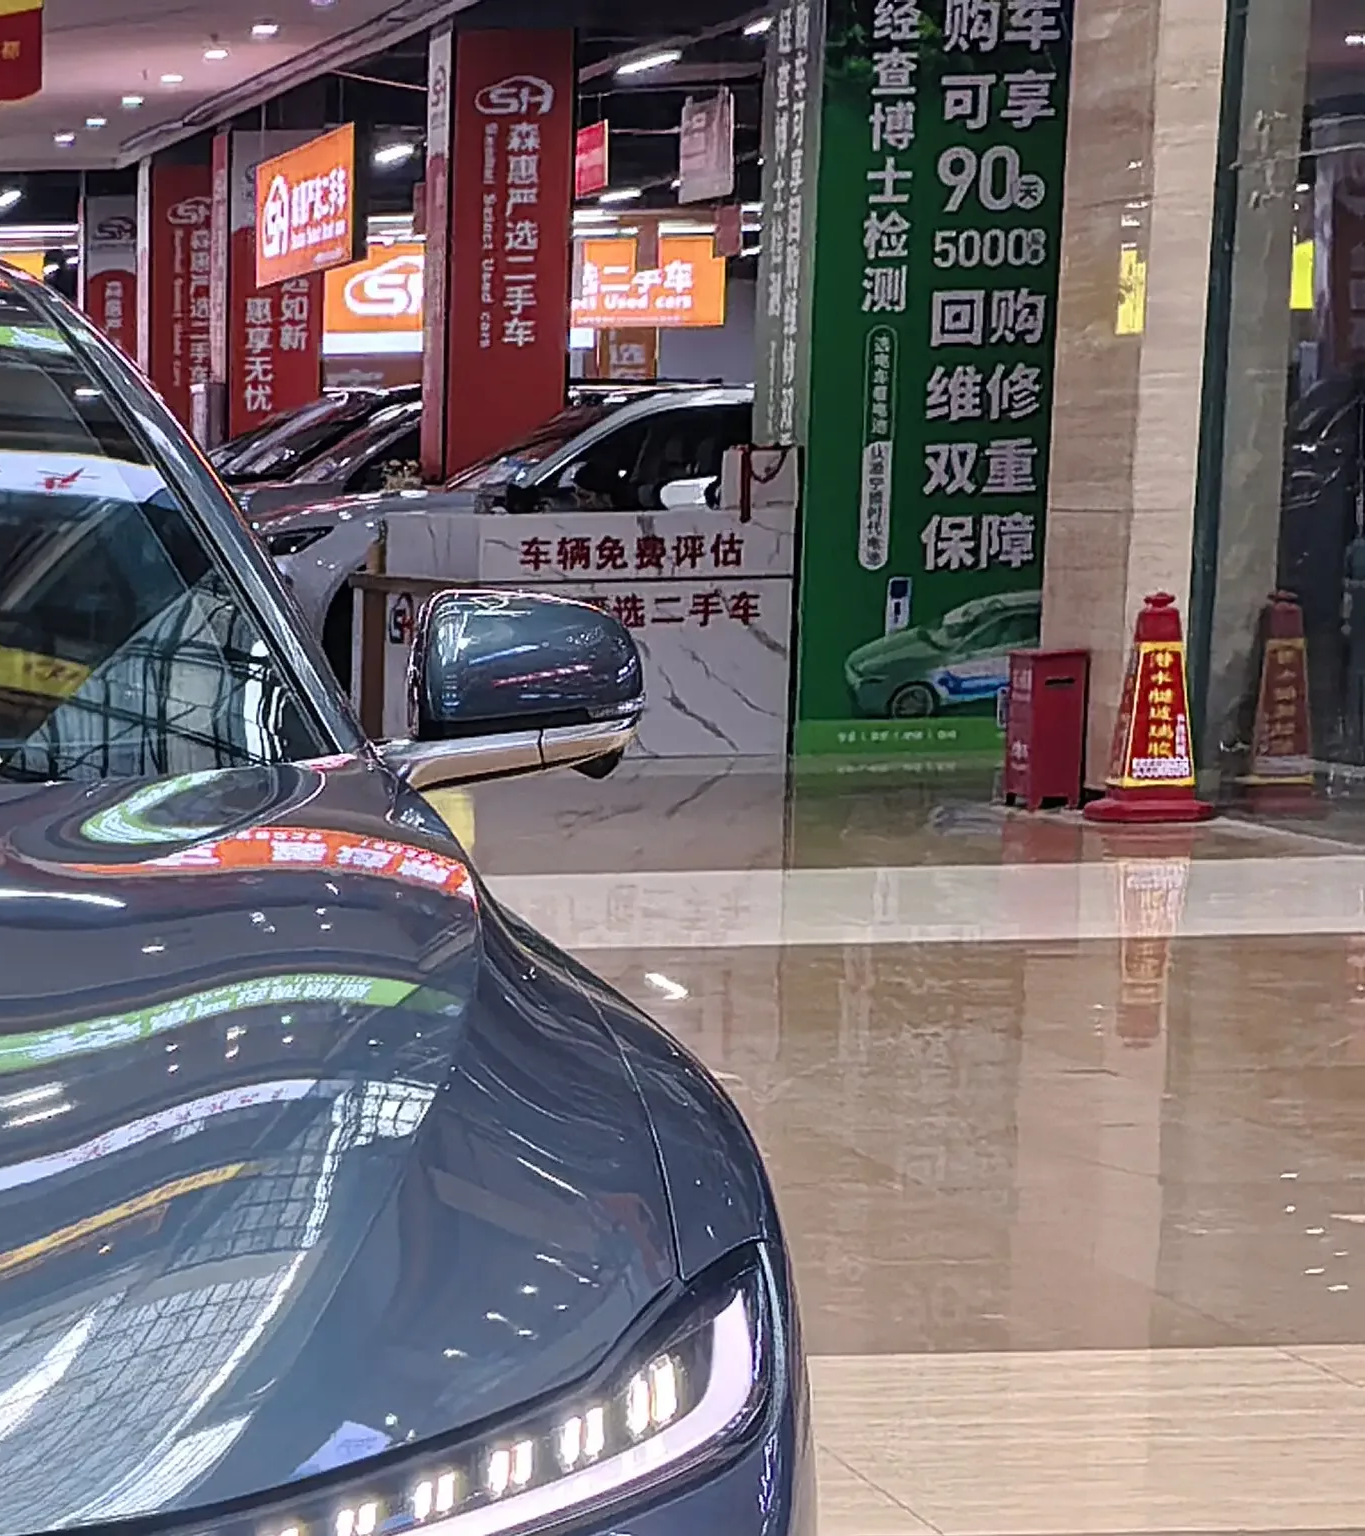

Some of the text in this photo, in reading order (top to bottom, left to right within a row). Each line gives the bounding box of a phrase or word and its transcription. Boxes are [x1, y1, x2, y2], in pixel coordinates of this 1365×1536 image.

[943, 0, 1062, 53] 购车
[941, 70, 1057, 130] 可享
[502, 121, 541, 347] 森惠严选二手车
[929, 287, 1047, 347] 回购
[925, 363, 1042, 422] 维修
[922, 438, 1038, 496] 双重
[519, 534, 745, 571] 车辆免费评估
[920, 513, 1037, 571] 保障
